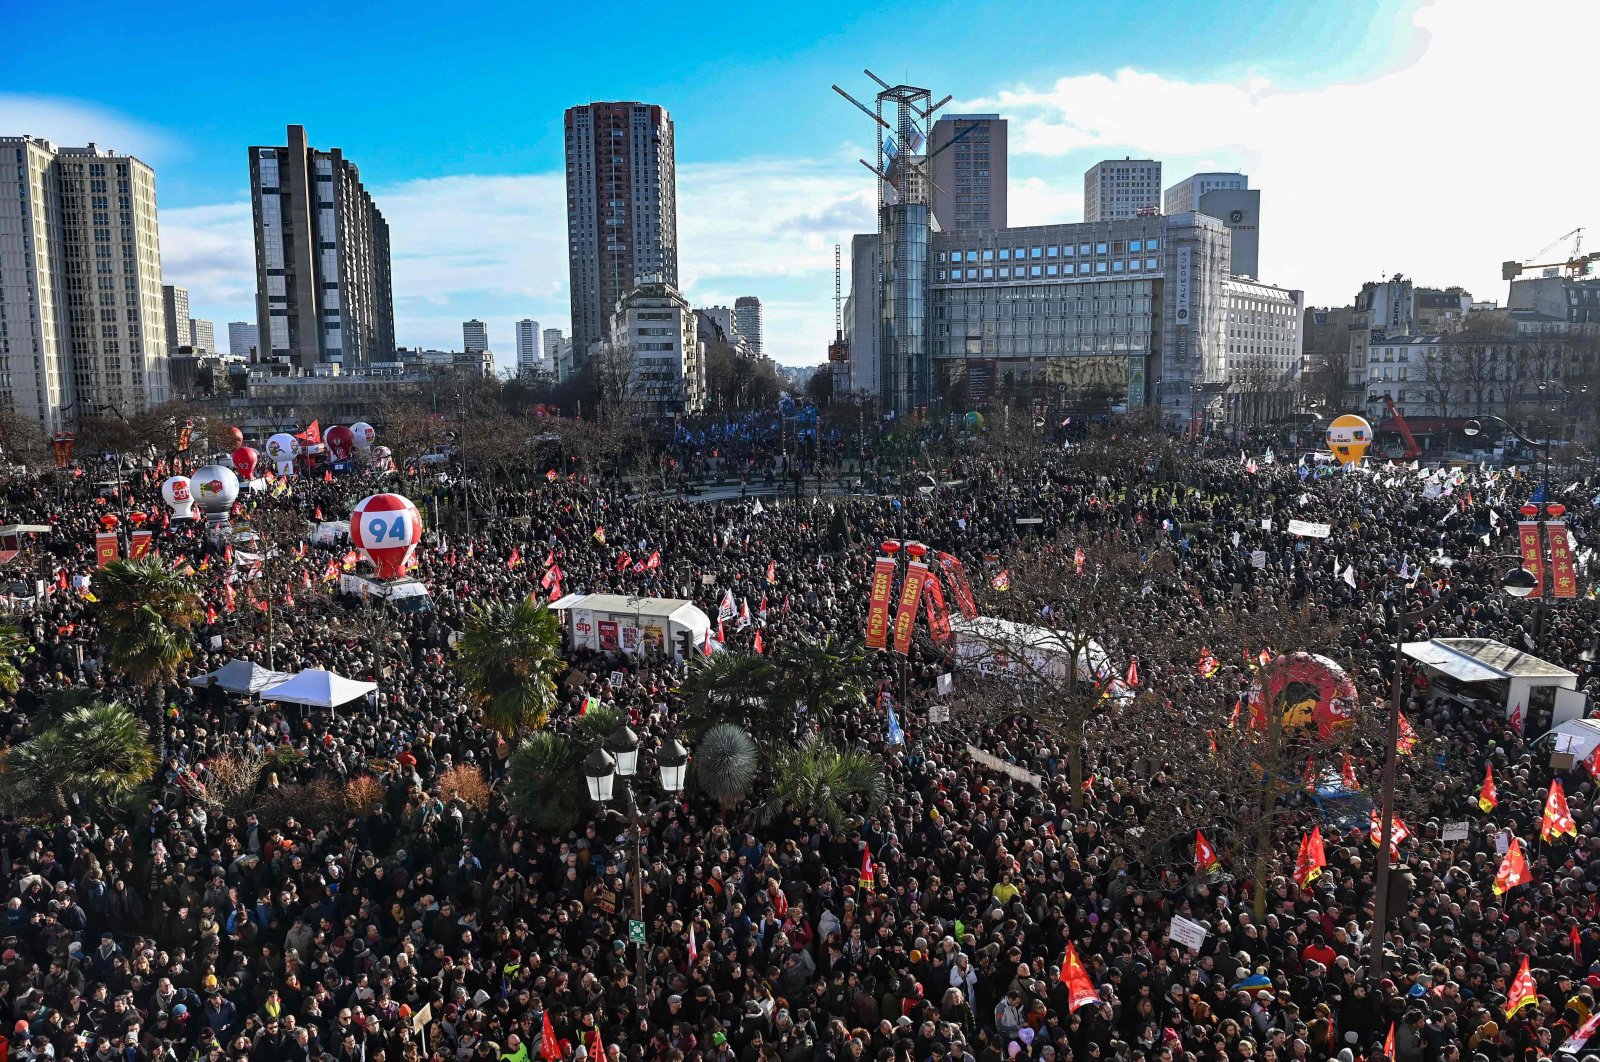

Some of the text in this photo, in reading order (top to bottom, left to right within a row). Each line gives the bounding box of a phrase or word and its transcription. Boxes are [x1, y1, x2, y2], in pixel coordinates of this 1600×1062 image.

[369, 516, 404, 543] 94
[1552, 534, 1571, 588] 合境平安
[902, 578, 920, 606] BONNE
